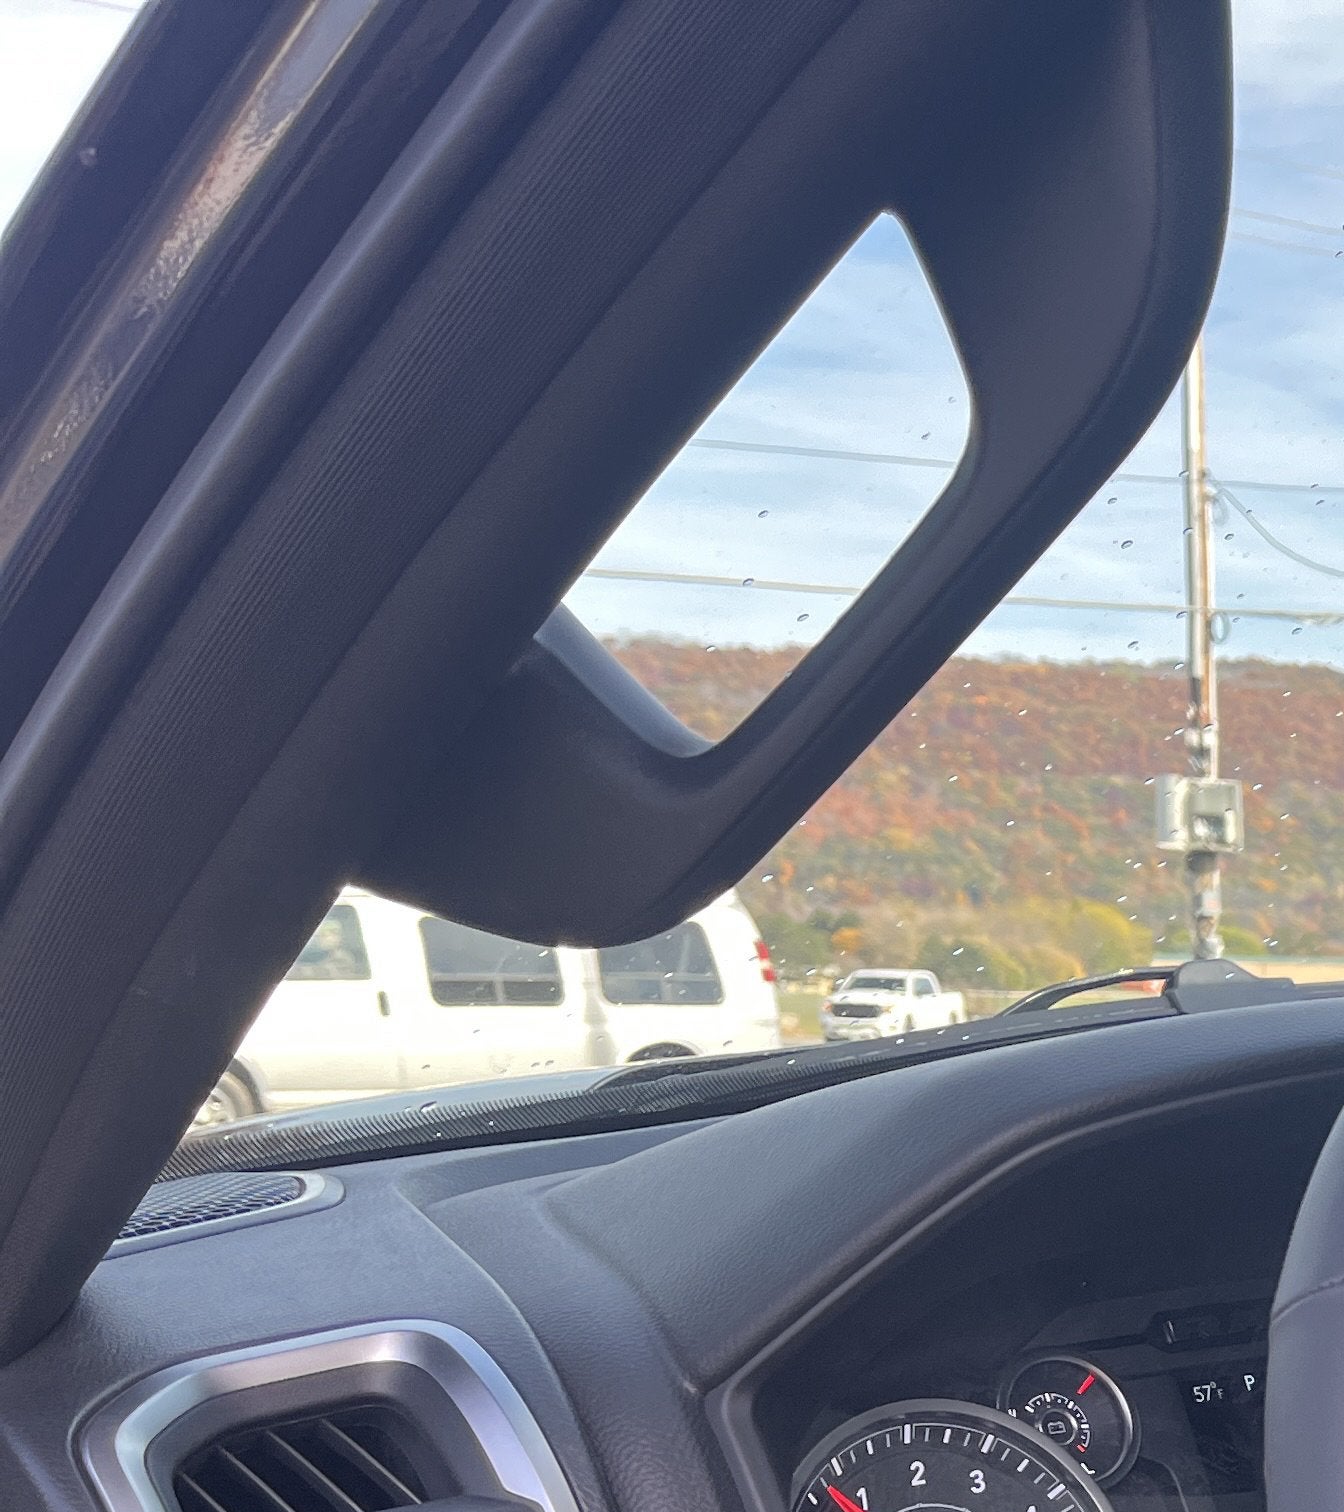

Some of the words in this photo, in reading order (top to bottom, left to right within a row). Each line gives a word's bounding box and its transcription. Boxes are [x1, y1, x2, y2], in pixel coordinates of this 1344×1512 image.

[1243, 1374, 1255, 1392] P
[910, 1460, 927, 1487] 2
[969, 1469, 987, 1494] 3
[856, 1487, 869, 1511] 1
